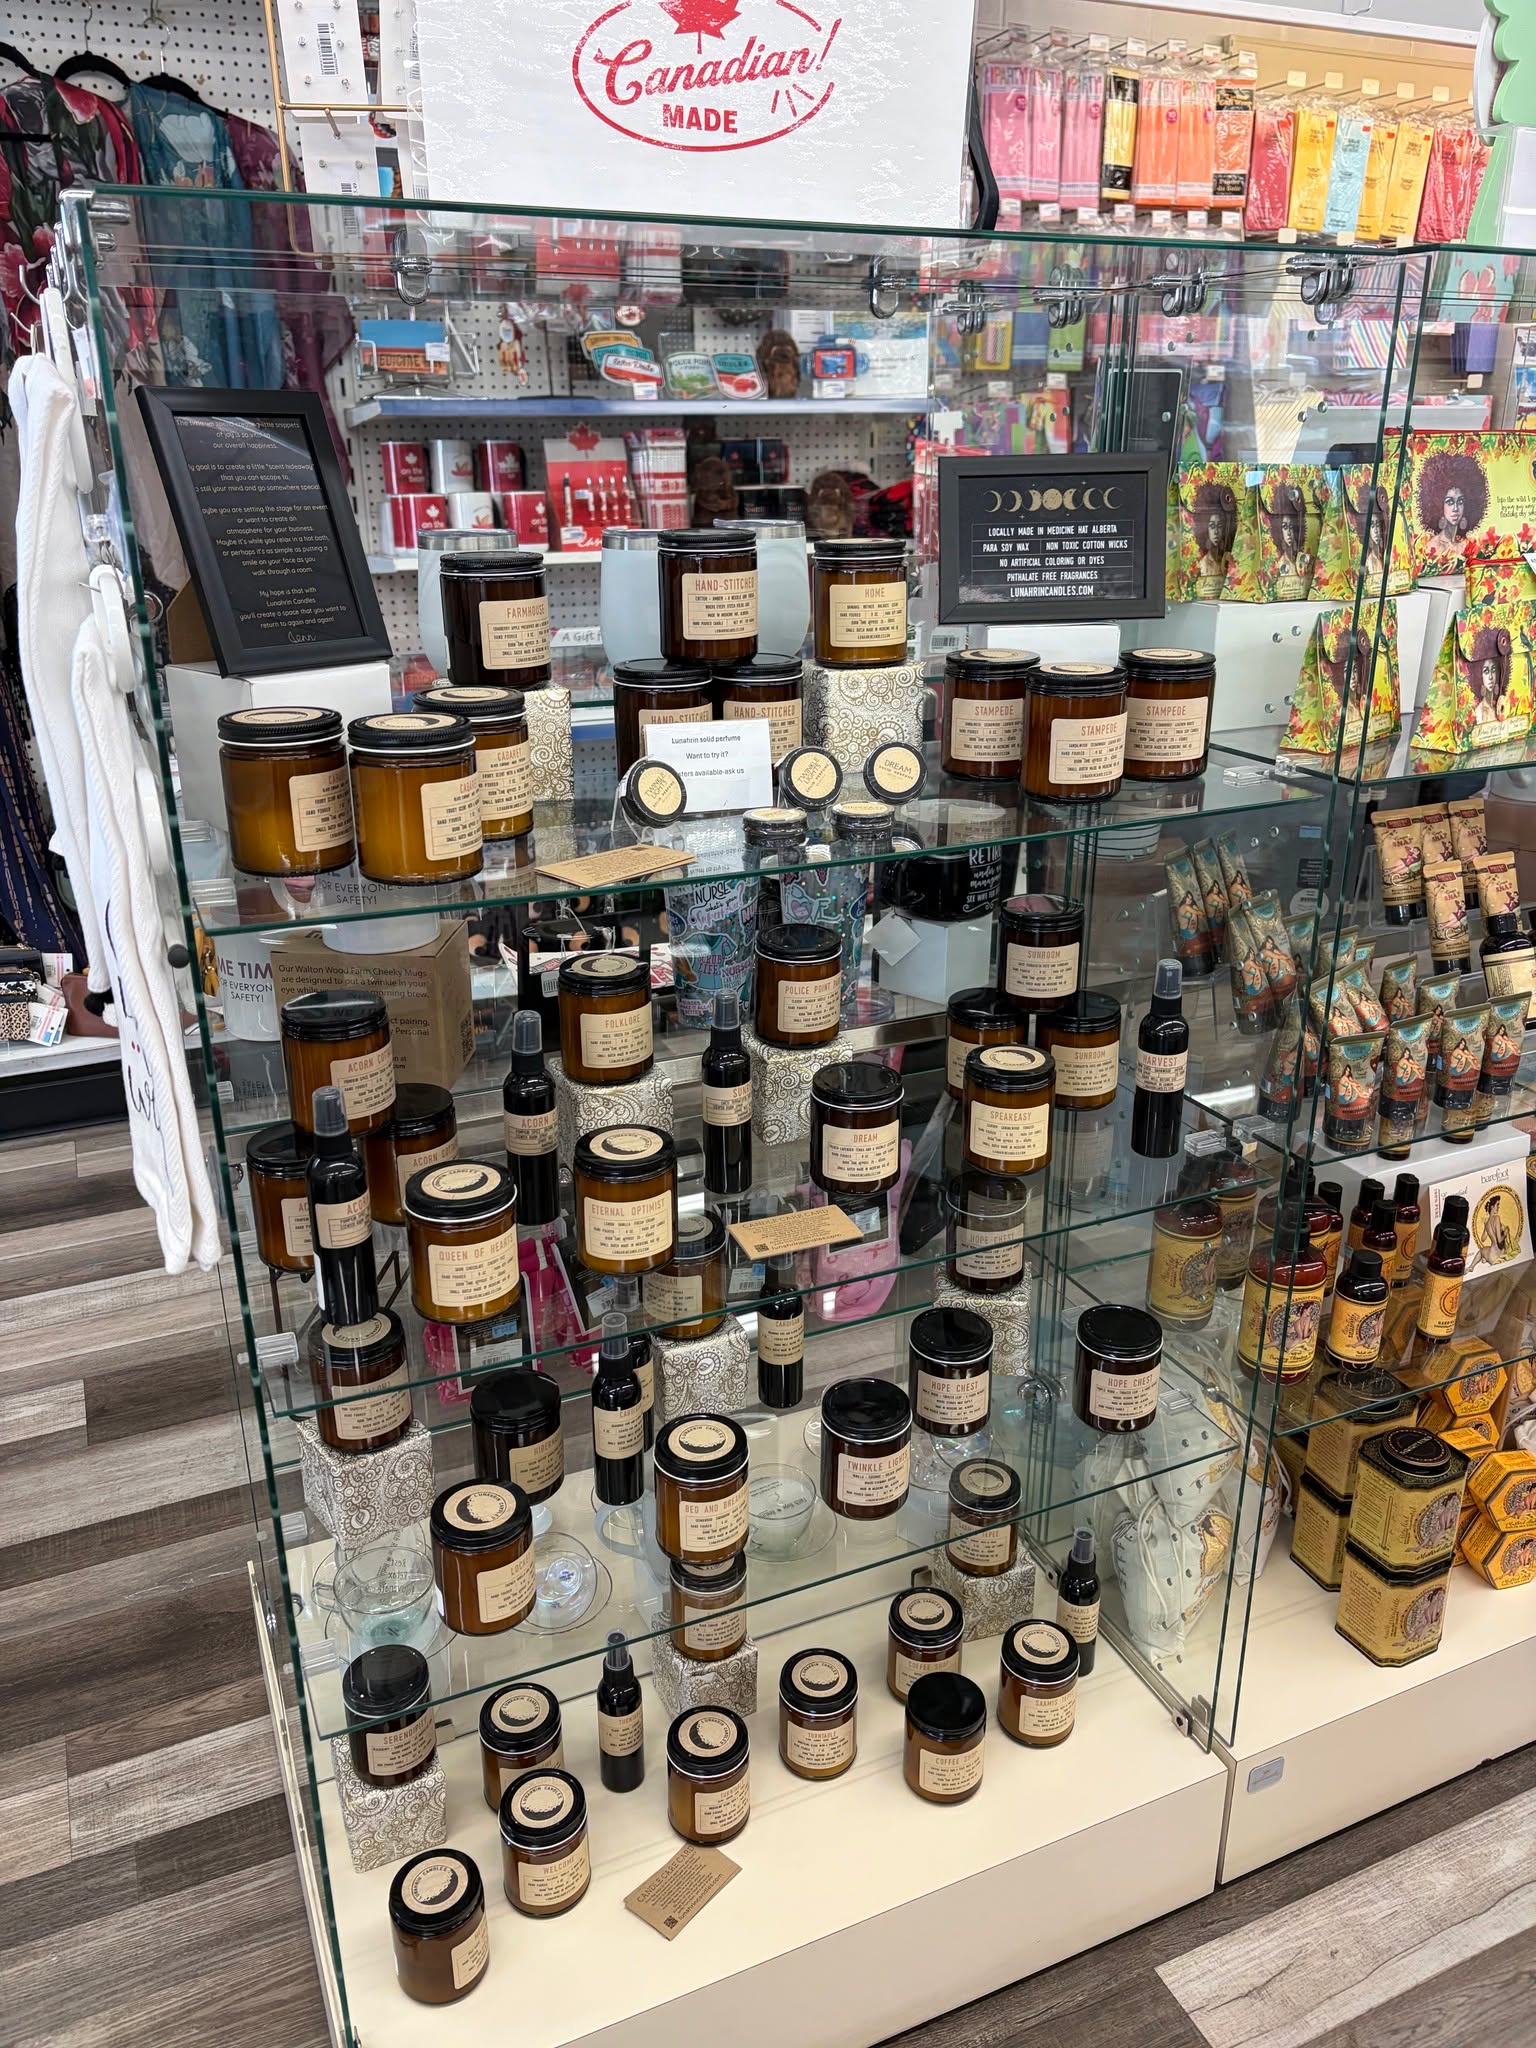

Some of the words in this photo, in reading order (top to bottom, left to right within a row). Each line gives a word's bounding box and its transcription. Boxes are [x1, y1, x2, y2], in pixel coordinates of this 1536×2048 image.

[594, 18, 842, 105] Canadian!
[662, 104, 738, 133] MADE
[988, 527, 1014, 537] LOCALLY
[1018, 527, 1034, 536] MADE
[1038, 527, 1044, 535] IN
[1047, 526, 1074, 535] MEDICINE
[1078, 525, 1088, 534] HAT
[1092, 524, 1117, 533] ALBERTA
[983, 544, 998, 552] PARA
[1001, 544, 1013, 552] SOY
[1016, 543, 1029, 551] WAX
[1046, 542, 1058, 550] NON
[1062, 541, 1079, 550] TOXIC
[1082, 540, 1105, 549] COTTON
[1108, 540, 1128, 549] WICKS
[1000, 558, 1008, 567] NO
[1011, 557, 1041, 567] ARTIFICIAL
[1045, 556, 1074, 566] COLORING
[1078, 556, 1086, 565] OR
[1089, 556, 1104, 565] DYES
[1007, 572, 1038, 582] PHTHALATE
[1042, 572, 1057, 581] FREE
[1060, 571, 1098, 580] FRAGRANCES
[696, 577, 754, 591] HAND-STITCHED
[865, 587, 885, 598] HOME
[1010, 585, 1093, 598] LUNAHRINCANDLES.COM
[507, 604, 545, 619] FARMHOUSE
[734, 705, 795, 719] HAND-STITCHED
[975, 705, 1014, 716] STAMPEDE
[1146, 705, 1186, 716] STAMPEDE
[1080, 723, 1117, 737] STAMPEDE
[671, 736, 699, 744] Lunahrin
[700, 735, 715, 744] solid
[717, 734, 741, 744] perfume
[686, 752, 700, 760] Want
[710, 752, 719, 761] try
[884, 759, 912, 775] DREAM
[695, 882, 729, 904] NURSE
[336, 894, 377, 905] SAFETY!
[1027, 950, 1060, 959] SUNROOM
[238, 962, 272, 979] TIM
[279, 965, 293, 973] Our
[295, 965, 323, 974] Walton
[325, 966, 349, 974] Wood
[373, 968, 402, 978] Cheeky
[404, 969, 427, 979] Mugs
[295, 975, 332, 986] designed
[785, 984, 811, 994] POLICE
[814, 982, 832, 993] POINT
[231, 992, 264, 1002] SAFETY!
[605, 1015, 640, 1029] FOLKLORE
[1075, 1050, 1106, 1060] SUNROOM
[348, 1060, 373, 1072] ACORN
[1143, 1055, 1178, 1067] HARVEST
[990, 1111, 1031, 1121] SPEAKEASY
[522, 1118, 548, 1129] ACORN
[854, 1134, 878, 1143] DREAM
[413, 1155, 438, 1167] ACORN
[1481, 1168, 1509, 1184] barefoot
[592, 1204, 625, 1216] ETERNAL
[632, 1198, 665, 1215] OPTIMIST
[439, 1250, 468, 1260] QUEEN
[474, 1248, 485, 1258] OF
[932, 1381, 950, 1392] HOPE
[956, 1381, 978, 1392] CHEST
[1108, 1378, 1128, 1388] HOPE
[848, 1461, 883, 1472] TWINKLE
[685, 1504, 700, 1514] BED
[704, 1503, 719, 1512] AND
[909, 1661, 933, 1670] COFFEE
[544, 1856, 574, 1874] WELCOME
[637, 1879, 664, 1902] CANDLE
[661, 1862, 678, 1879] CARE
[676, 1846, 695, 1863] CARD
